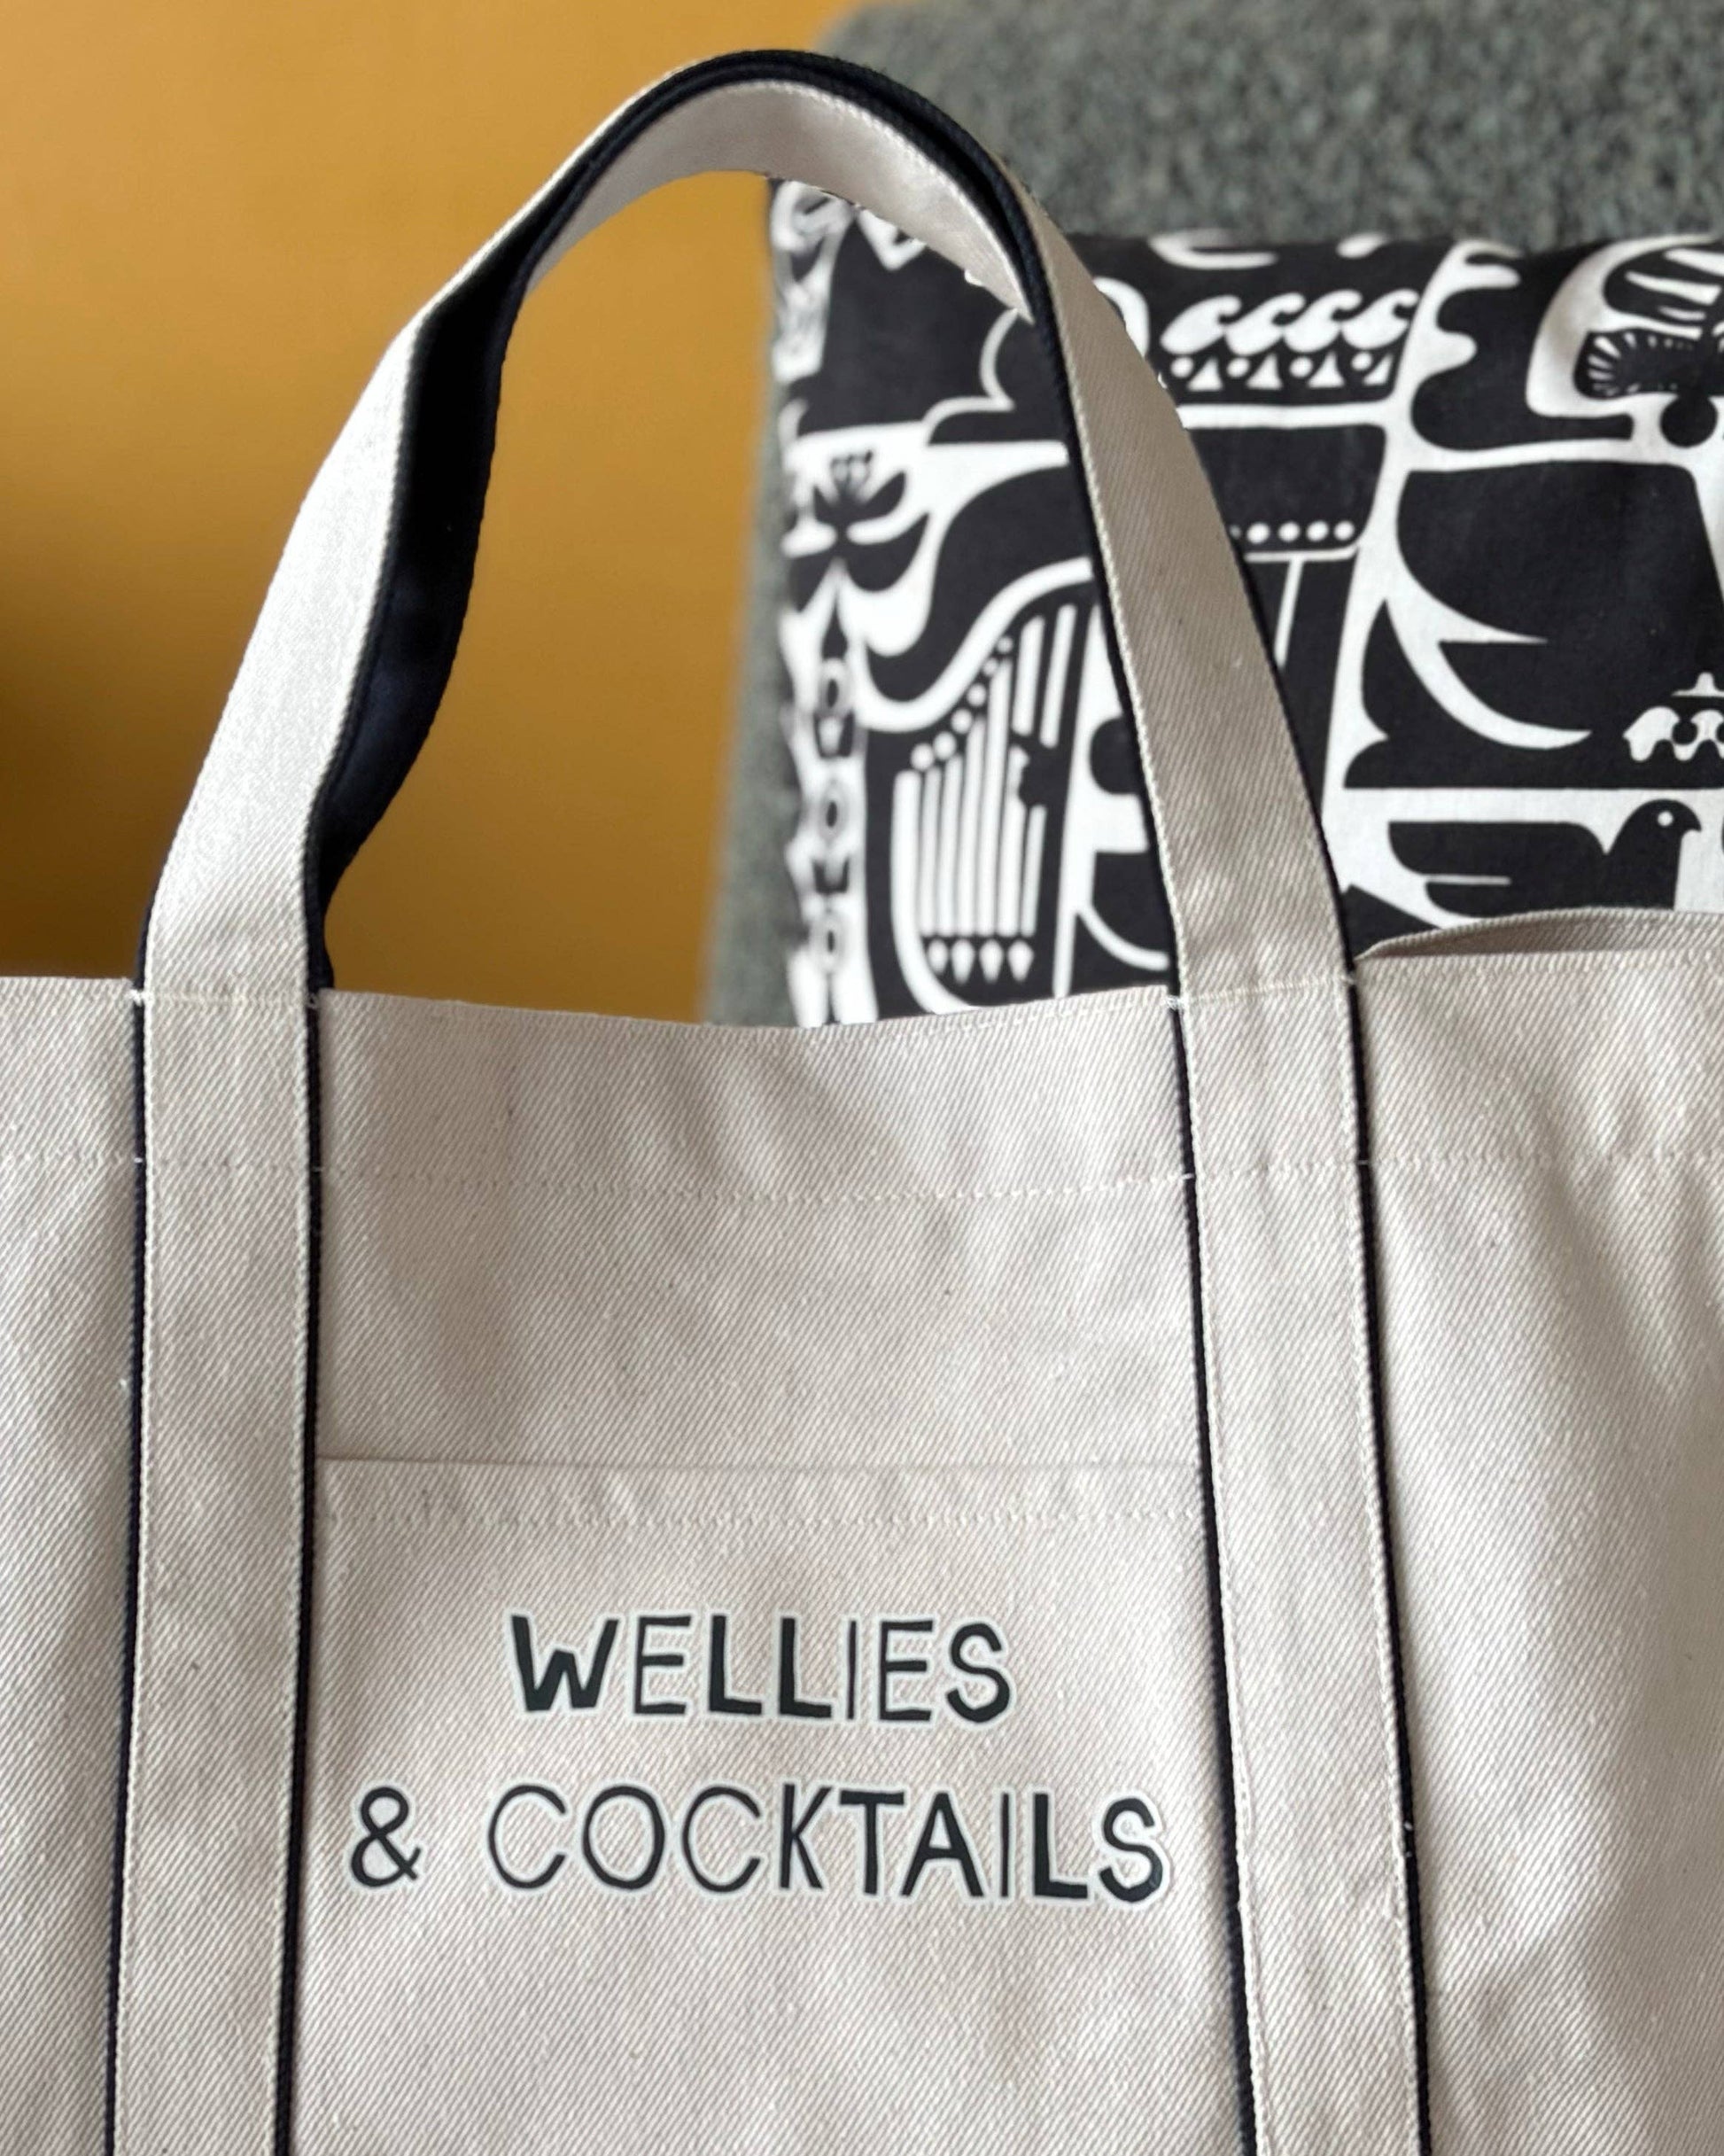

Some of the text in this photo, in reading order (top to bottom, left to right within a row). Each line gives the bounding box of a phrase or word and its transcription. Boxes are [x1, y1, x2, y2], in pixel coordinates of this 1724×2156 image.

[510, 1614, 1012, 1724] WELLIES
[350, 1783, 1164, 1903] & COCKTAILS
